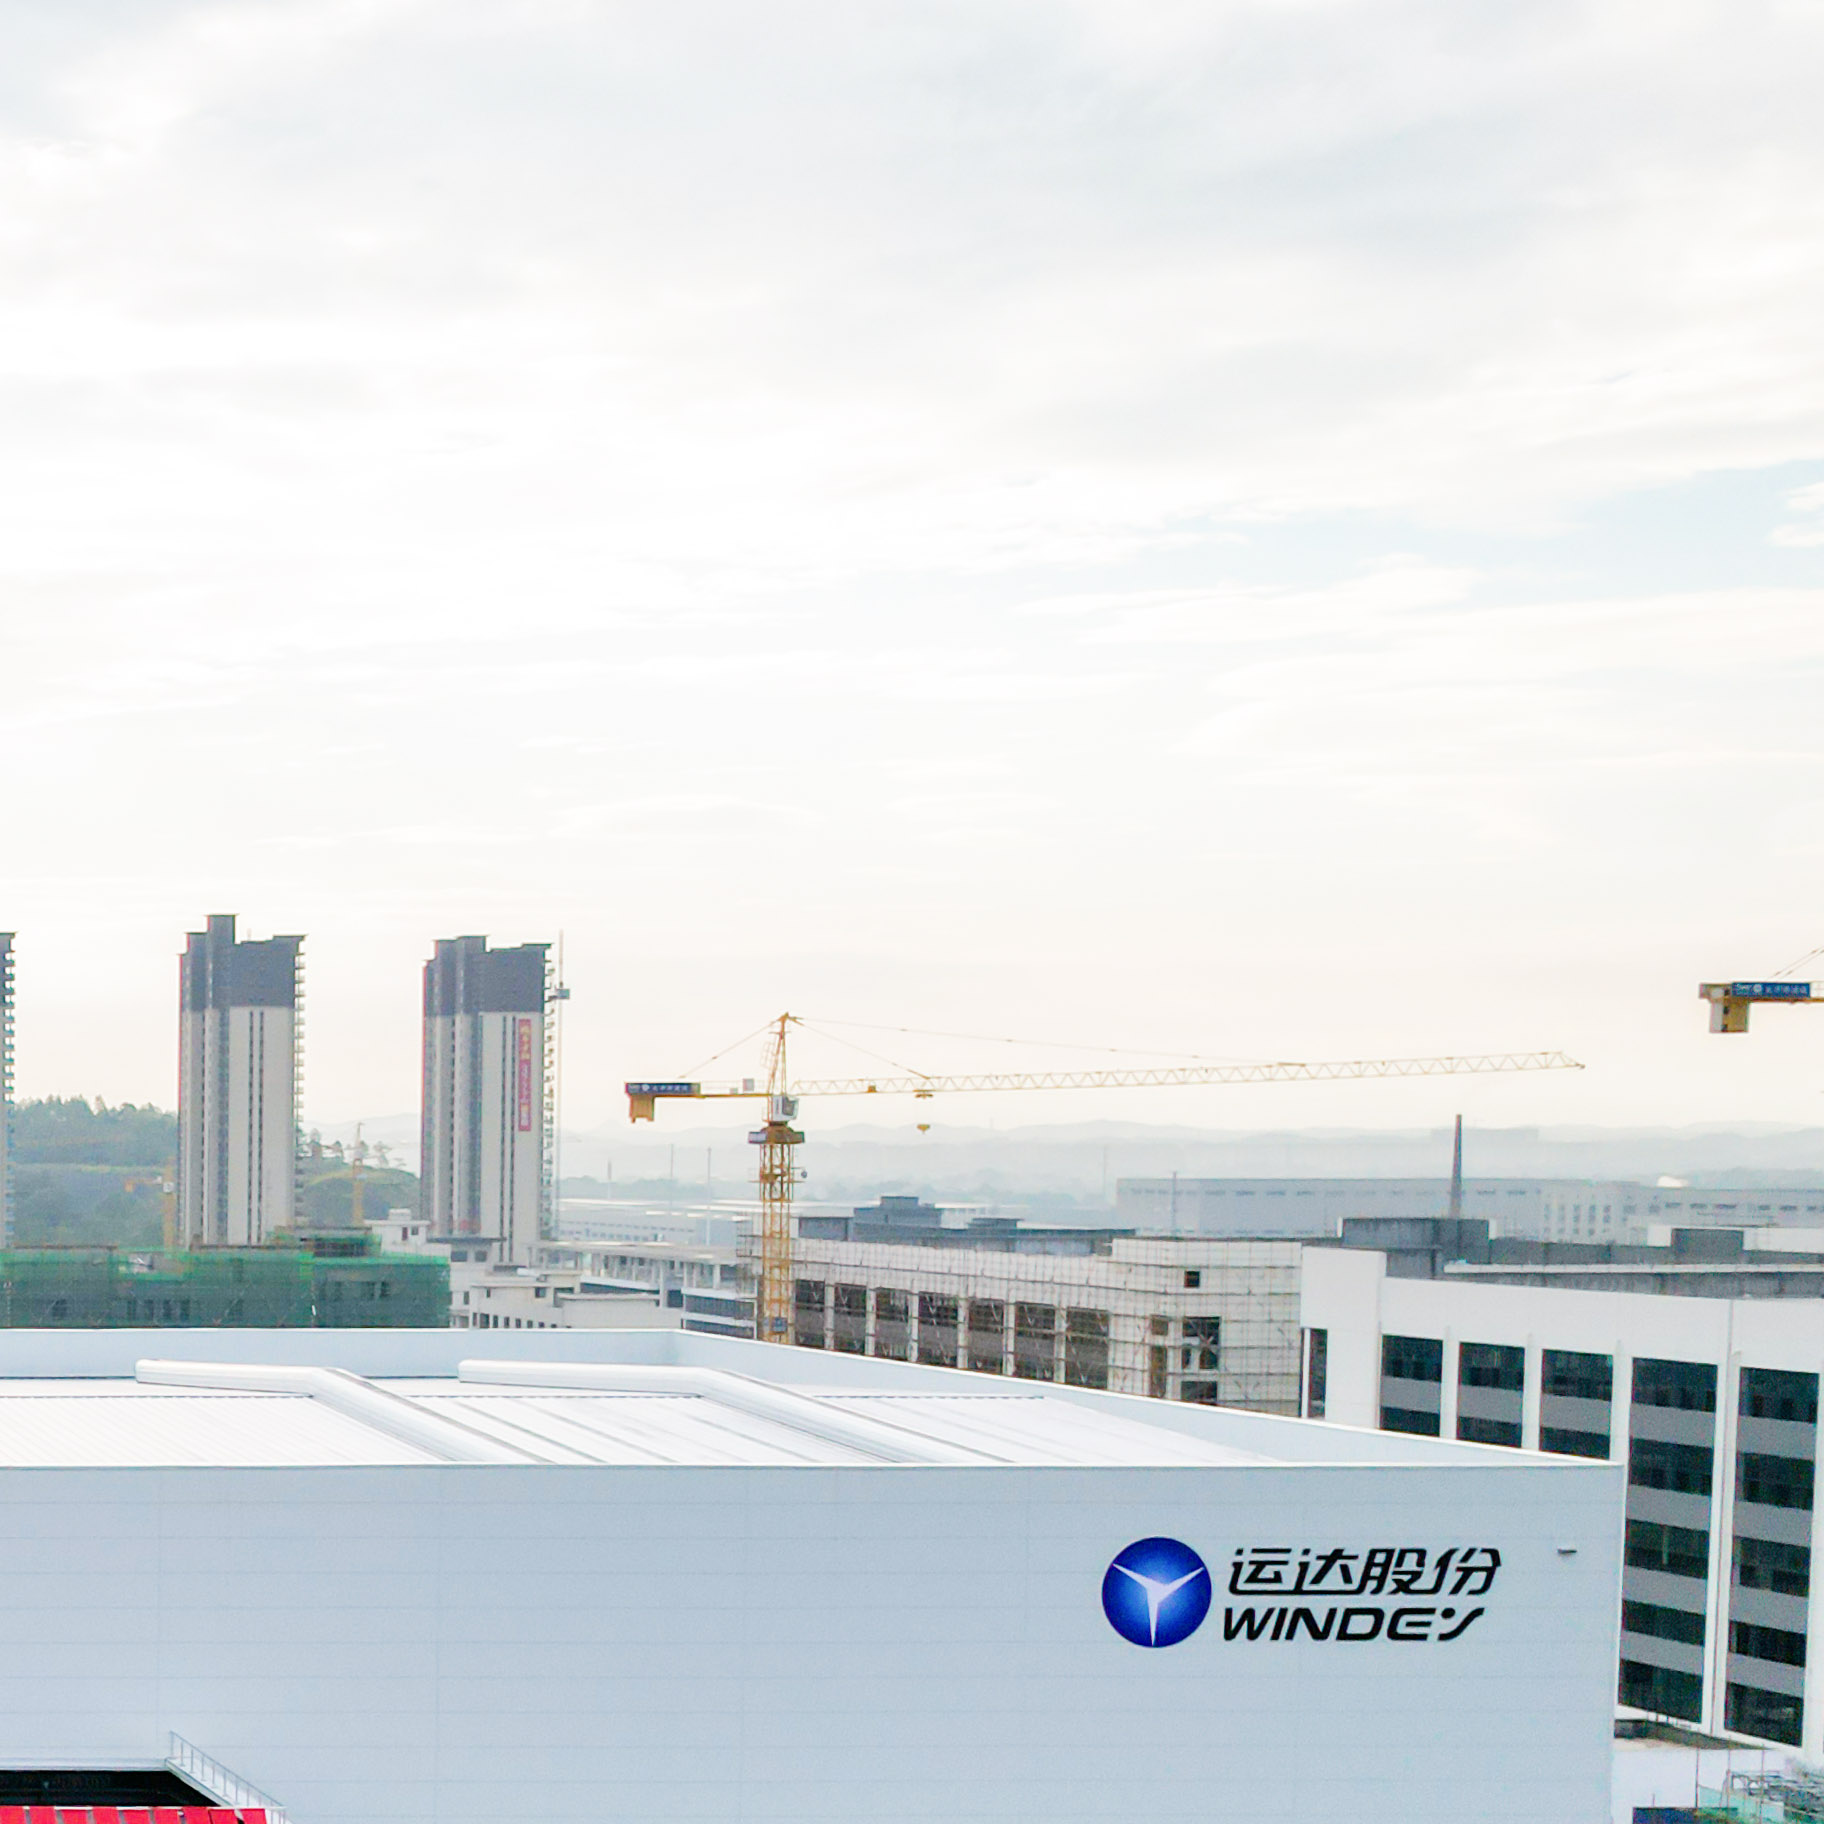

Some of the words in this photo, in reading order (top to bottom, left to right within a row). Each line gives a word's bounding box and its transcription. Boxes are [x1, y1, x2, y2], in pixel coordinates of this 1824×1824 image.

[1228, 1546, 1502, 1597] 运达股份
[1222, 1606, 1485, 1642] WINDEY
